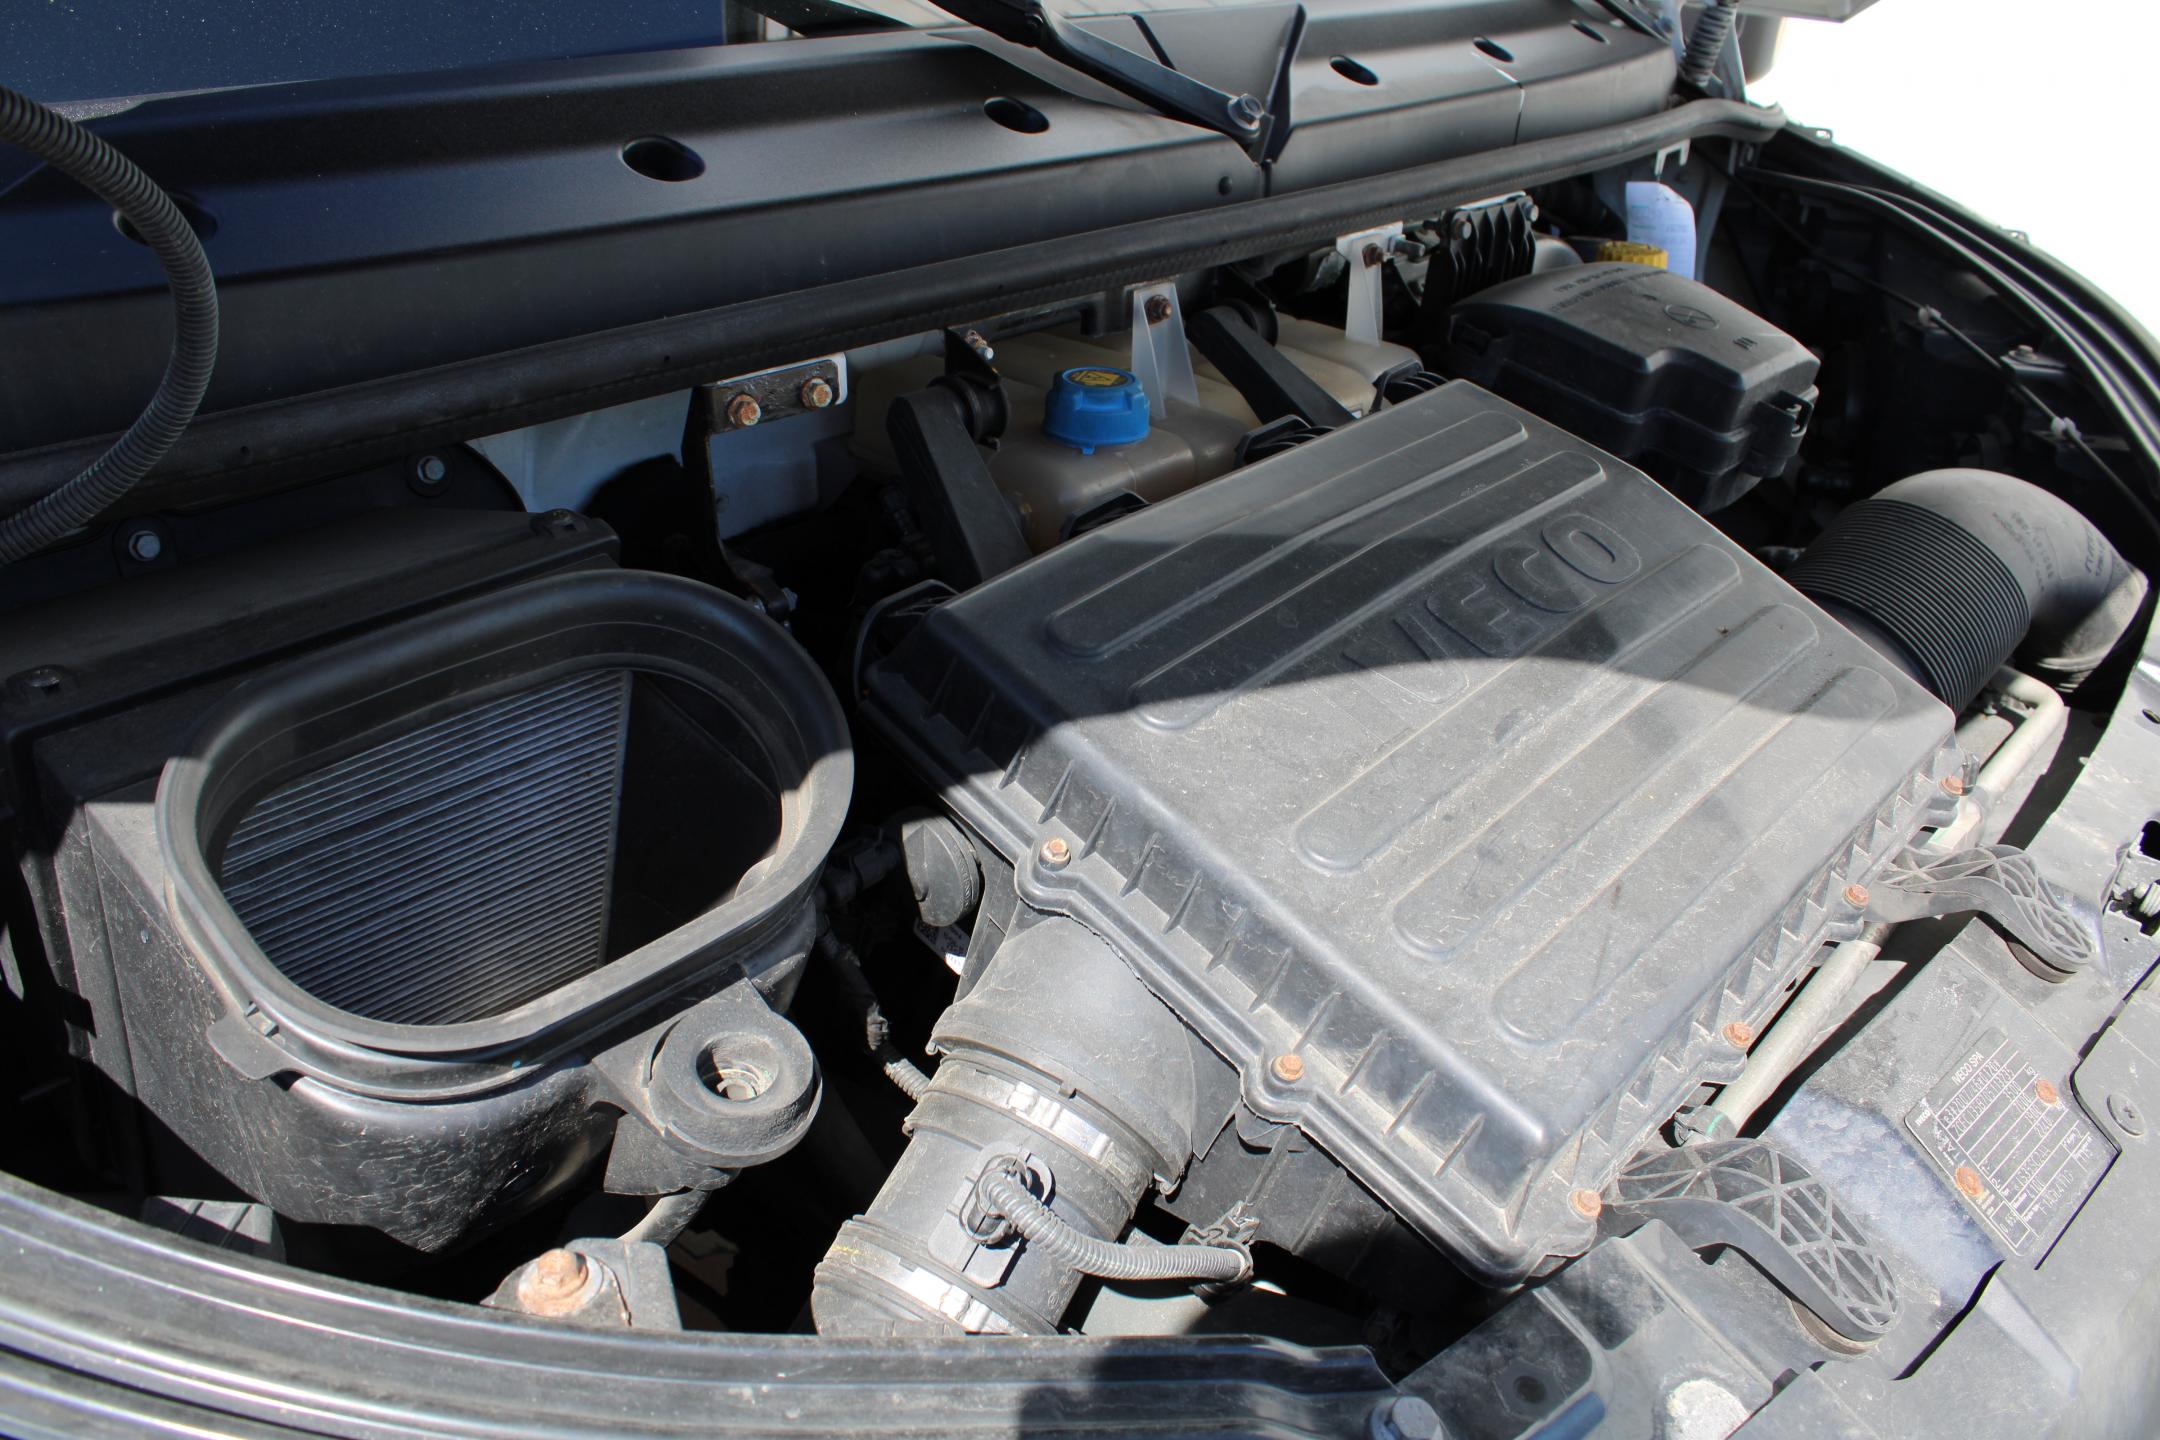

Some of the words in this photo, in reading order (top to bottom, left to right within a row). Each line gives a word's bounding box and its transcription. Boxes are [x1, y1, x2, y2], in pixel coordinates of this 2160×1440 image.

[1310, 512, 1642, 744] IVECO
[1951, 1061, 1973, 1086] IVECO
[1968, 1050, 1984, 1067] SPA
[1914, 1108, 1930, 1127] IVECO
